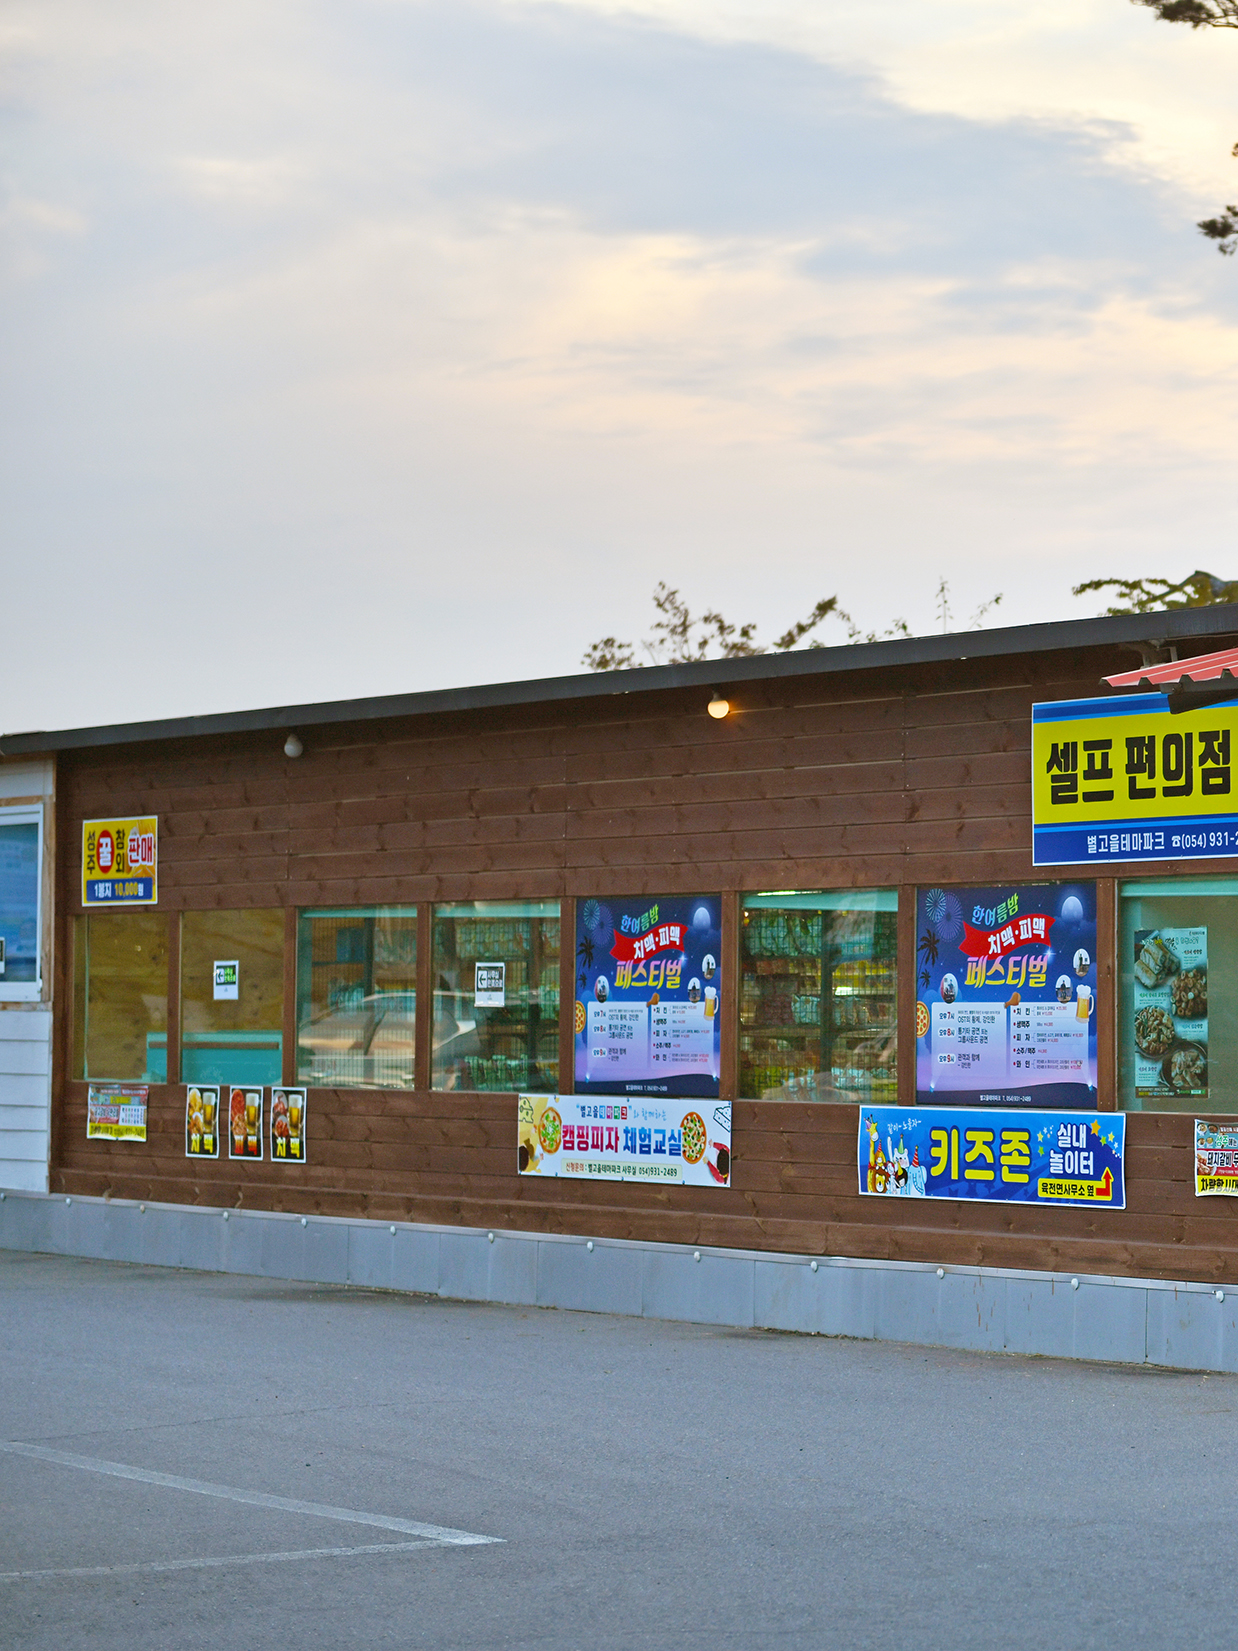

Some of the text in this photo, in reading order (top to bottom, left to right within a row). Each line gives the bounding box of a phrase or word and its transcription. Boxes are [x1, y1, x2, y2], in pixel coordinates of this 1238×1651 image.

[1046, 739, 1114, 805] 셀프
[1125, 729, 1231, 800] 편의점
[128, 834, 154, 865] 판매
[1087, 832, 1165, 854] 별고을테마파크
[620, 904, 659, 934] 한여름밤
[971, 893, 1019, 928] 한여름밤
[614, 959, 682, 990] 페스티벌
[964, 954, 1049, 988] 페스티벌
[562, 1124, 682, 1157] 캠핑피자 체험교실
[1057, 1123, 1087, 1148] 실내
[930, 1128, 1031, 1183] 키즈존
[1049, 1149, 1094, 1175] 놀이터
[1207, 1151, 1232, 1167] 돼지갈비
[1086, 1184, 1094, 1197] 옆
